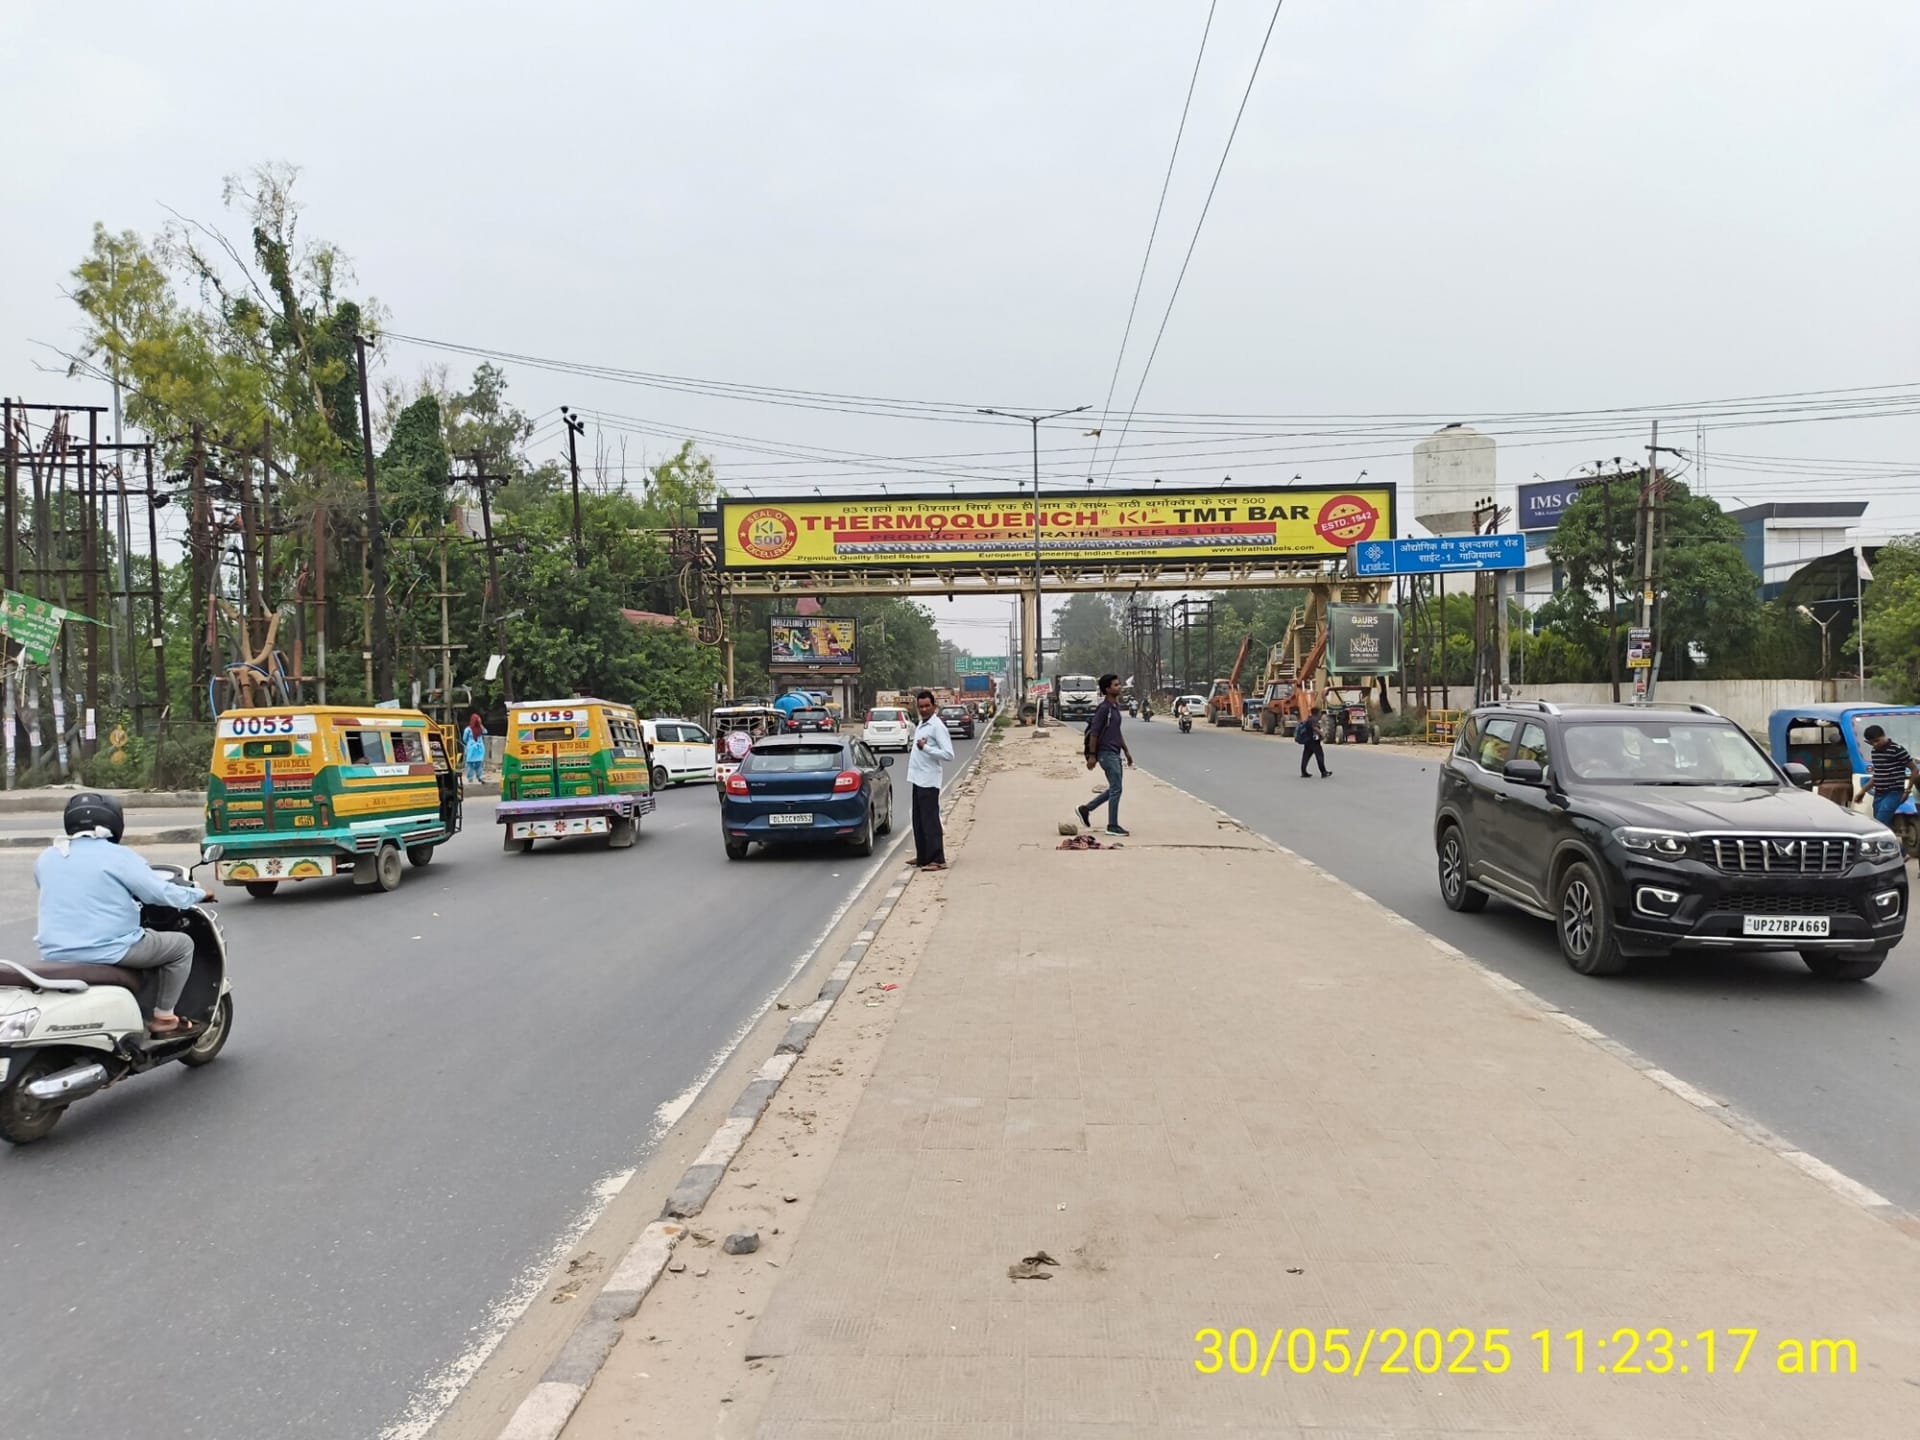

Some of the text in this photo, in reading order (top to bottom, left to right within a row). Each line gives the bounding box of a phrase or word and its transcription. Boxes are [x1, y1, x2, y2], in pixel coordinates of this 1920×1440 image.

[842, 506, 858, 514] 83
[897, 504, 913, 512] का
[918, 503, 960, 512] विश्वास
[997, 503, 1017, 511] एक
[1022, 501, 1033, 510] ही
[1039, 502, 1060, 510] नाम
[1066, 501, 1077, 509] के
[1203, 497, 1213, 506] के
[1218, 498, 1237, 506] एल
[1242, 497, 1266, 505] 500
[1530, 494, 1562, 509] IMS
[1173, 507, 1238, 523] TMT
[1248, 505, 1310, 521] BAR
[1351, 511, 1372, 523] 1942
[754, 535, 782, 545] 500
[870, 532, 968, 541] PRODUCT
[1111, 528, 1189, 536] STEELS
[1504, 537, 1519, 547] रोड
[978, 552, 1023, 560] European
[1115, 549, 1158, 557] Expertise
[530, 710, 574, 722] 0139
[233, 715, 294, 735] 0053
[520, 745, 550, 755] S.S.
[226, 762, 262, 775] S.S.
[1752, 918, 1828, 933] UP27BP4669
